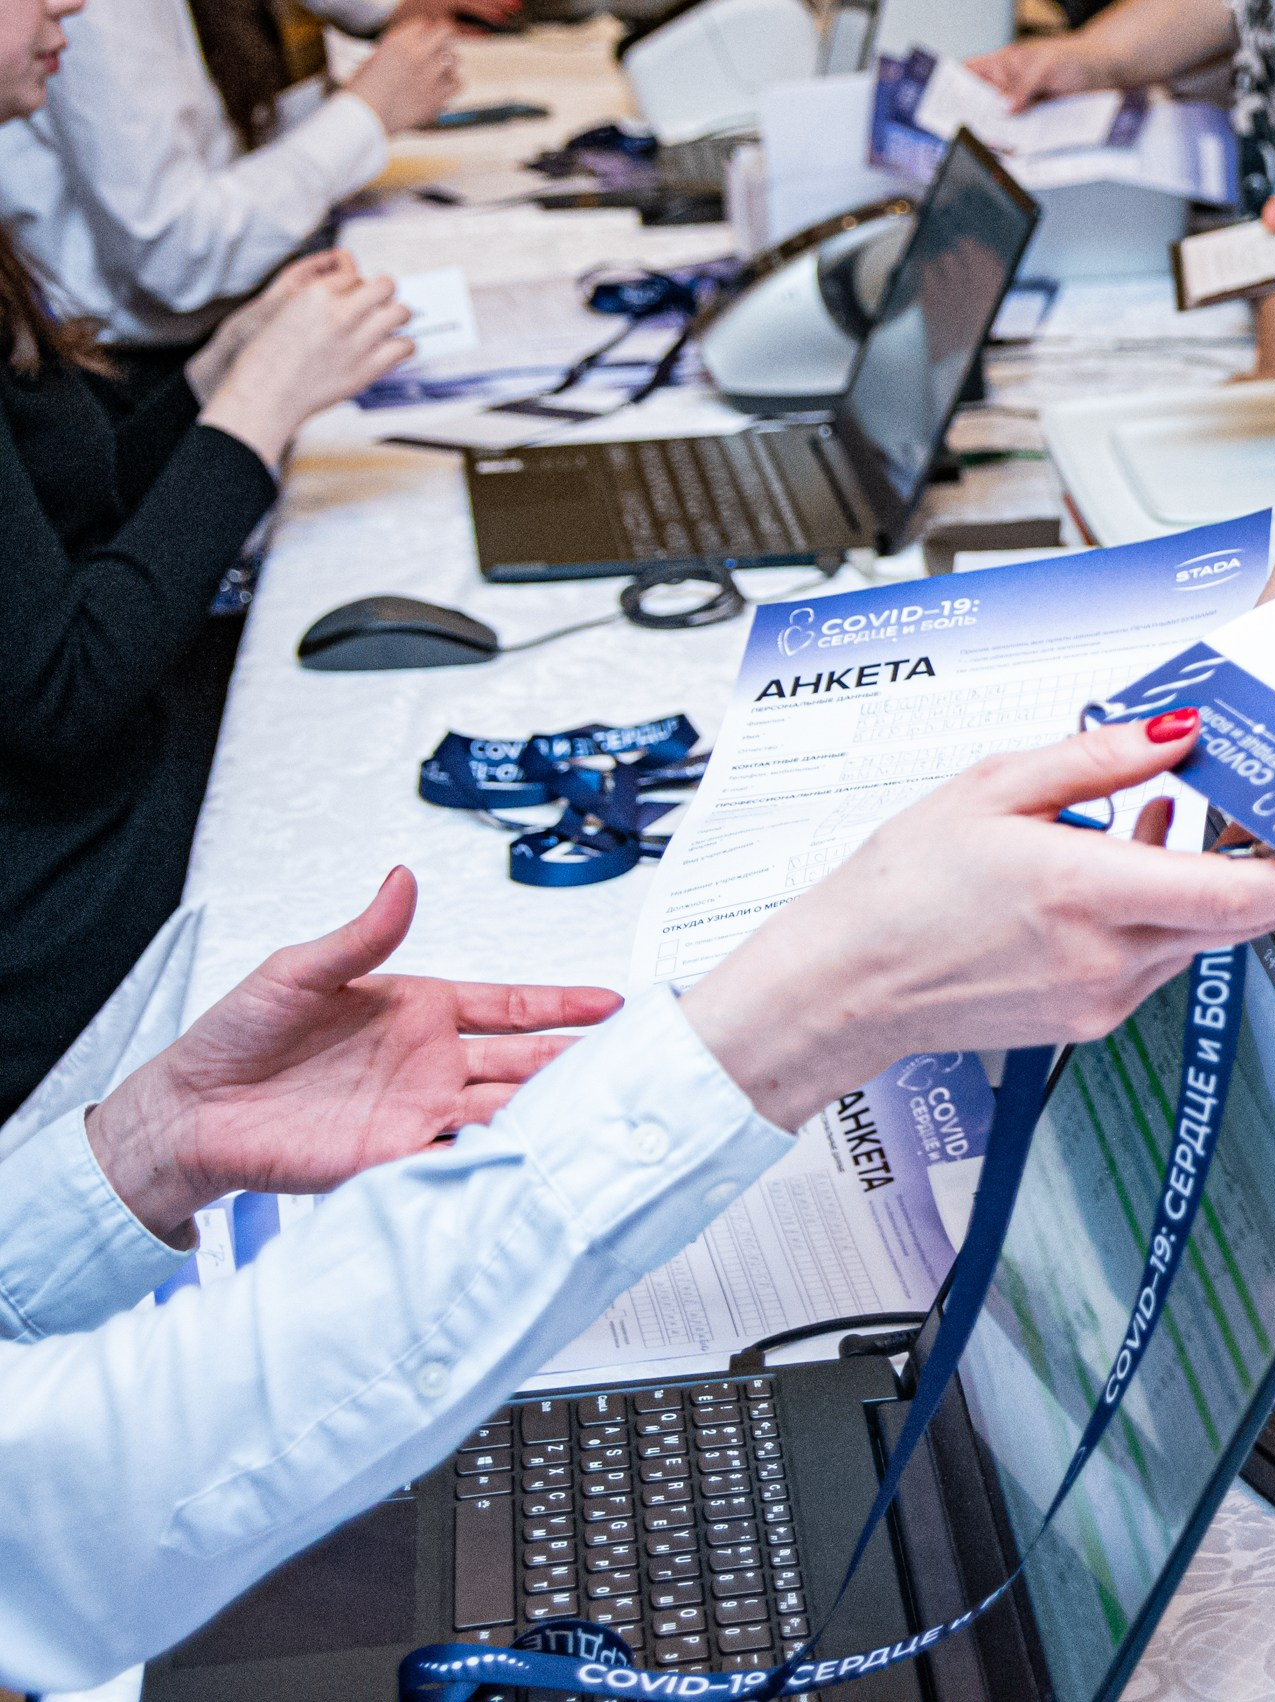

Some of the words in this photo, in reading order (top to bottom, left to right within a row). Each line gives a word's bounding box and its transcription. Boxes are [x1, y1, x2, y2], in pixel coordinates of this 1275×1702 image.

[1176, 558, 1241, 583] STADA
[817, 626, 897, 649] СЕРДЦЕ
[921, 615, 977, 632] БОЛЬ
[821, 598, 980, 635] COVID-19:
[755, 656, 936, 702] АНКЕТА
[731, 757, 799, 771] КОНТАКТНЫЕ
[1200, 726, 1275, 786] COVID-
[662, 919, 704, 934] ОТКУДА
[707, 907, 751, 924] УЗНАЛИ
[753, 905, 762, 913] О
[764, 894, 801, 910] МЕРОП
[837, 1090, 895, 1193] АНКЕТА
[909, 1096, 941, 1151] СЕРДЦЕ
[1103, 1226, 1177, 1404] COVID-19:
[1164, 1066, 1218, 1222] СЕРДЦЕ
[1196, 1037, 1222, 1063] и
[787, 1625, 944, 1686] СЕРДЦЕ
